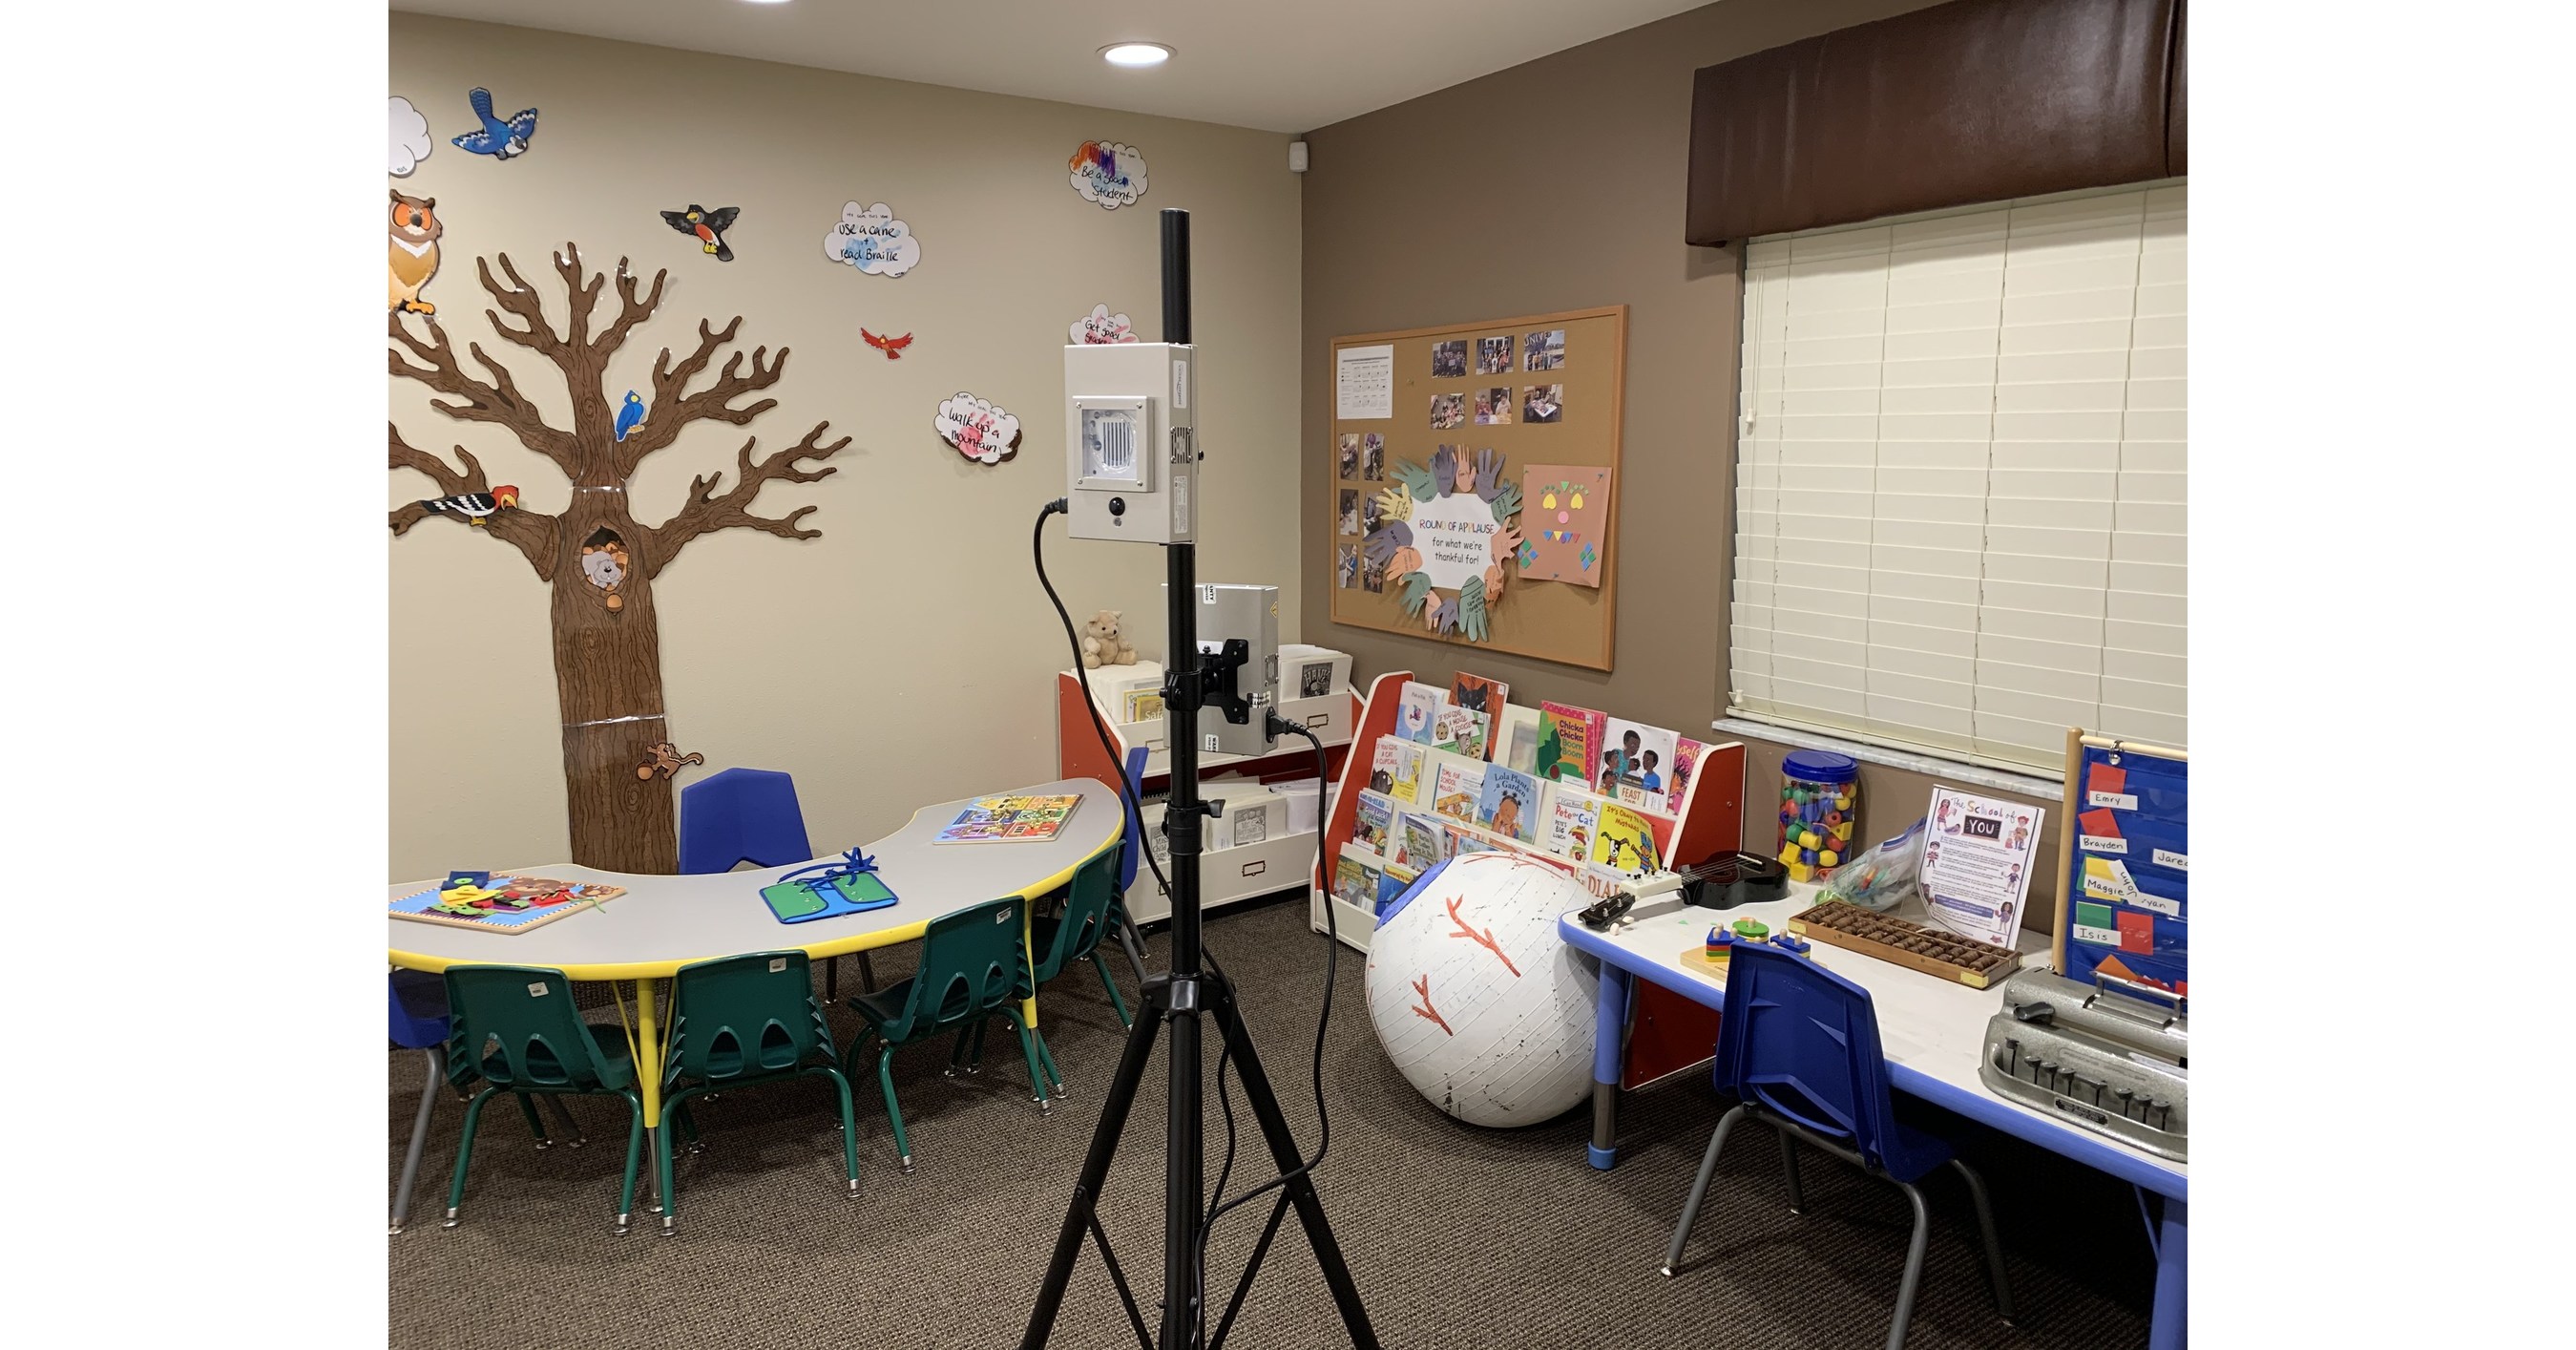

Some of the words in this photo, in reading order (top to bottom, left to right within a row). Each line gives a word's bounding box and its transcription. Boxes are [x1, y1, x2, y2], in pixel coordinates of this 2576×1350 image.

[1081, 165, 1094, 179] Be
[1096, 172, 1102, 181] a
[859, 224, 867, 236] a
[869, 225, 896, 239] cane
[840, 248, 862, 261] read
[866, 248, 899, 262] Braille
[1085, 319, 1100, 333] Get
[1101, 327, 1120, 341] good
[975, 422, 990, 438] up
[992, 430, 999, 439] a
[952, 429, 996, 453] mountain
[1419, 518, 1446, 531] ROUND
[1448, 521, 1456, 532] OF
[1458, 522, 1495, 535] APPLAUSE
[1432, 537, 1443, 547] for
[1445, 538, 1461, 549] what
[1463, 540, 1482, 551] we're
[1435, 552, 1464, 563] thankful
[1465, 554, 1479, 565] for!
[1560, 720, 1583, 733] Chicka
[1560, 728, 1583, 742] Chicka
[1561, 739, 1583, 751] Boom
[1561, 747, 1583, 759] Boom
[1676, 745, 1700, 763] yself
[1495, 772, 1509, 781] Lola
[1511, 773, 1529, 792] Plants
[1502, 780, 1526, 797] Garden
[1622, 788, 1641, 800] FEAST
[2095, 793, 2121, 806] Emry
[1556, 805, 1573, 819] Pete
[1579, 813, 1594, 827] Cat
[1606, 806, 1619, 815] It's
[1620, 809, 1633, 821] Okay
[1951, 797, 1966, 809] The
[1967, 800, 2003, 817] School
[2005, 811, 2017, 824] of
[1615, 817, 1640, 833] Mistakes
[1969, 819, 1995, 834] YOU
[2084, 837, 2124, 851] Brayden
[2087, 878, 2125, 896] Maggie
[2120, 871, 2138, 897] John
[2080, 928, 2108, 941] Isis
